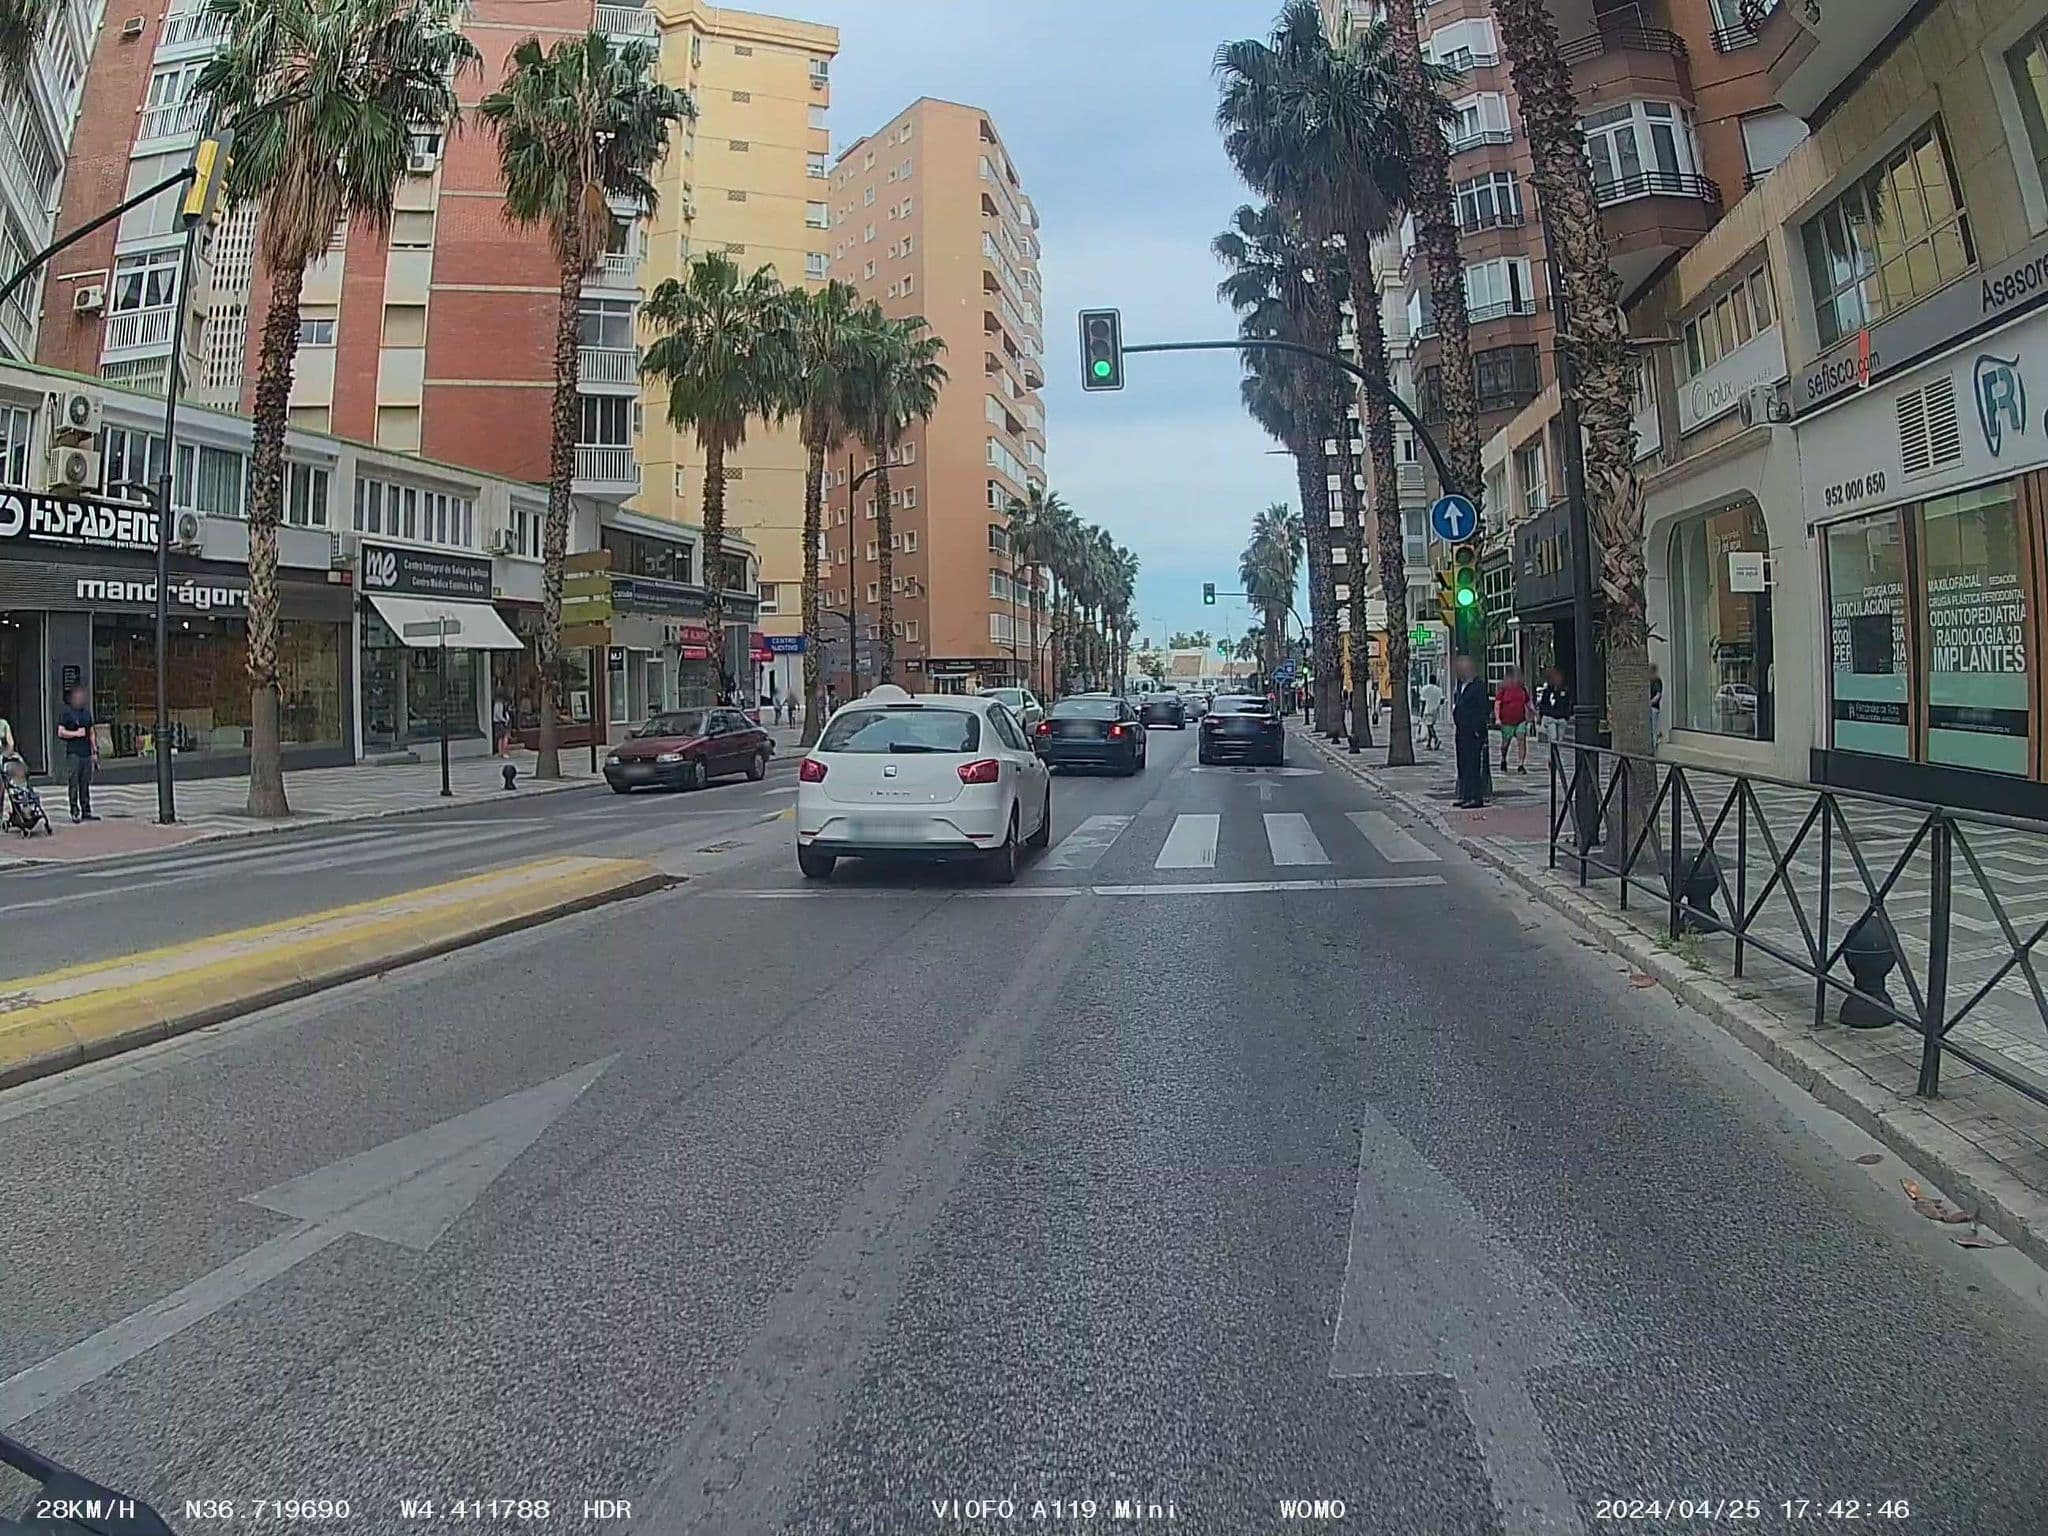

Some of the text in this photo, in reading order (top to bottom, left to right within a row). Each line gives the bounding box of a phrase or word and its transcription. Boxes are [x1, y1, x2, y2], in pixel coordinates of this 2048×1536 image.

[1807, 350, 1880, 399] sefisco.com
[1825, 471, 1885, 508] 952 000 650
[2006, 625, 2022, 645] 3D
[1933, 644, 2027, 673] IMPLANTES
